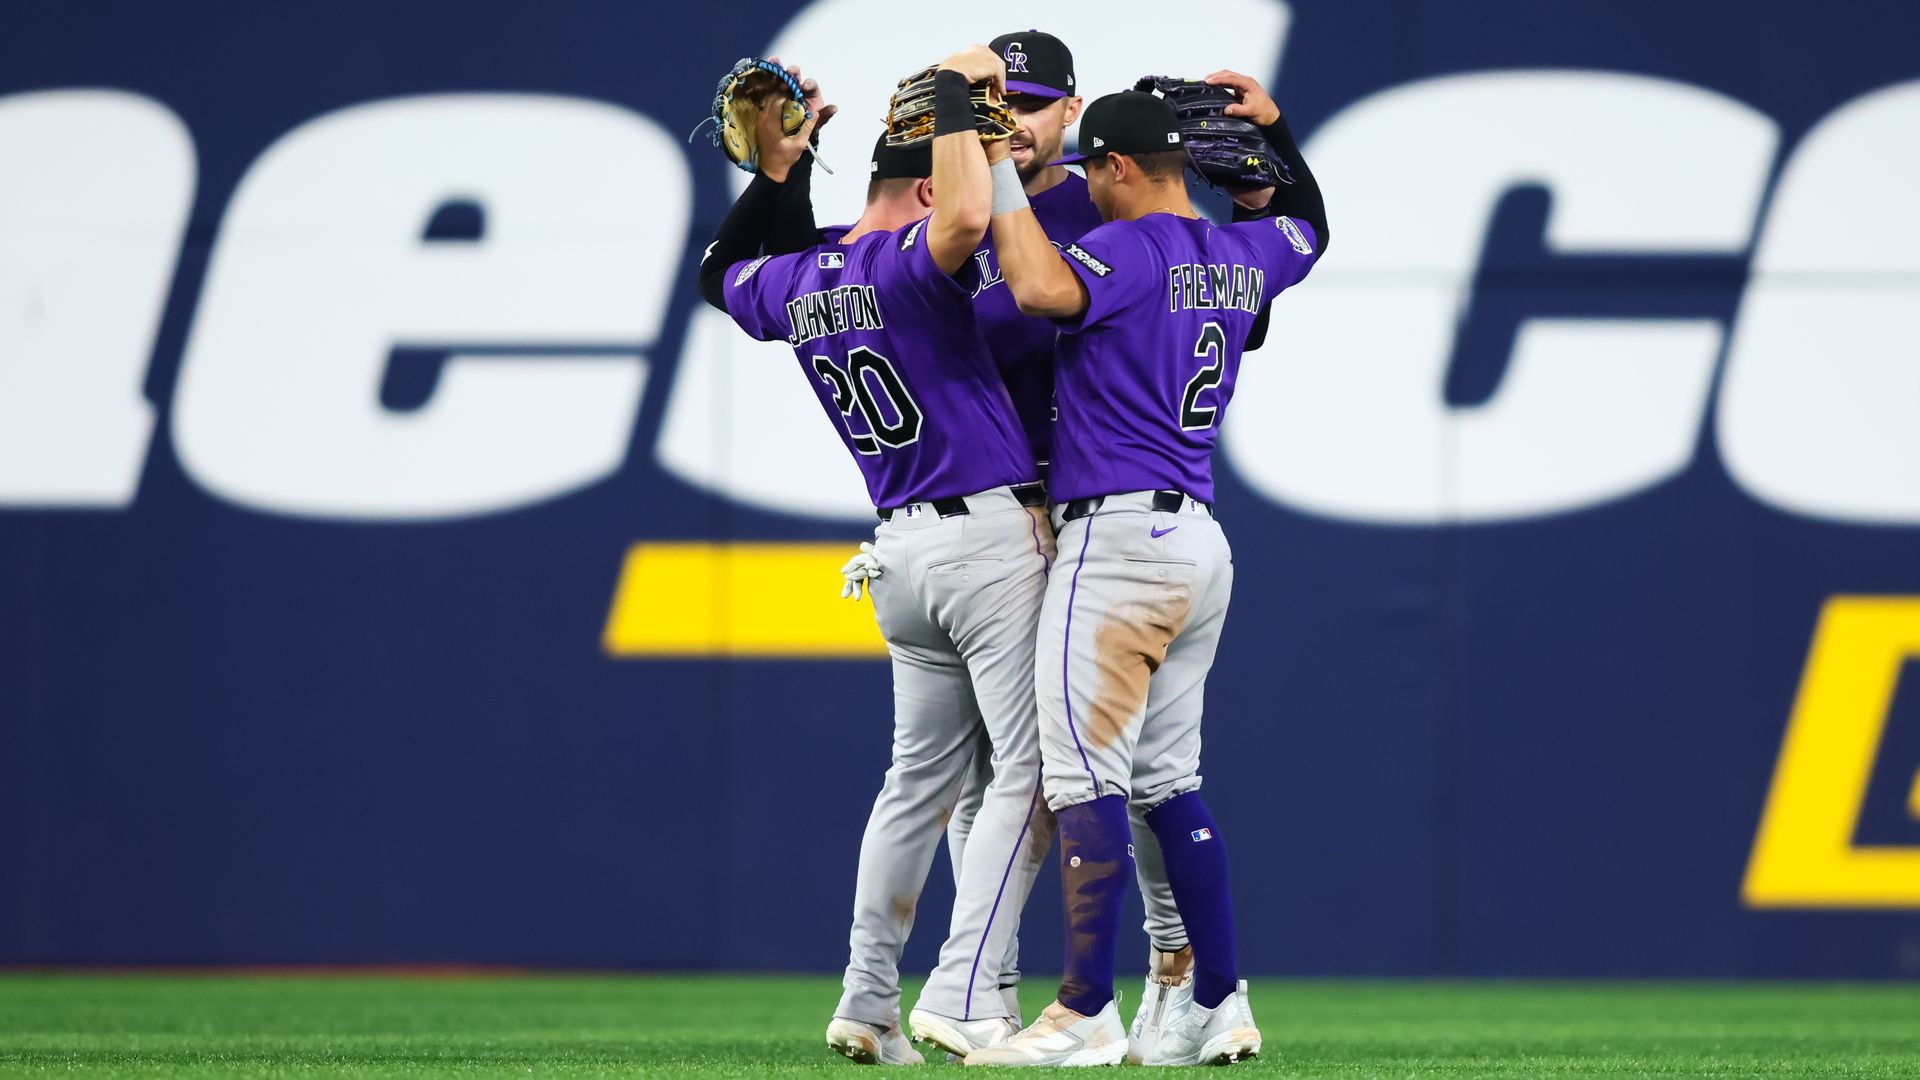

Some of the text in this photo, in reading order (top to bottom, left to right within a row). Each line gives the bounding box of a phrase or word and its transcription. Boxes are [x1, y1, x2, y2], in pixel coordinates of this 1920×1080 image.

[1004, 42, 1029, 73] CR
[813, 346, 924, 455] 20
[1180, 322, 1226, 431] 2
